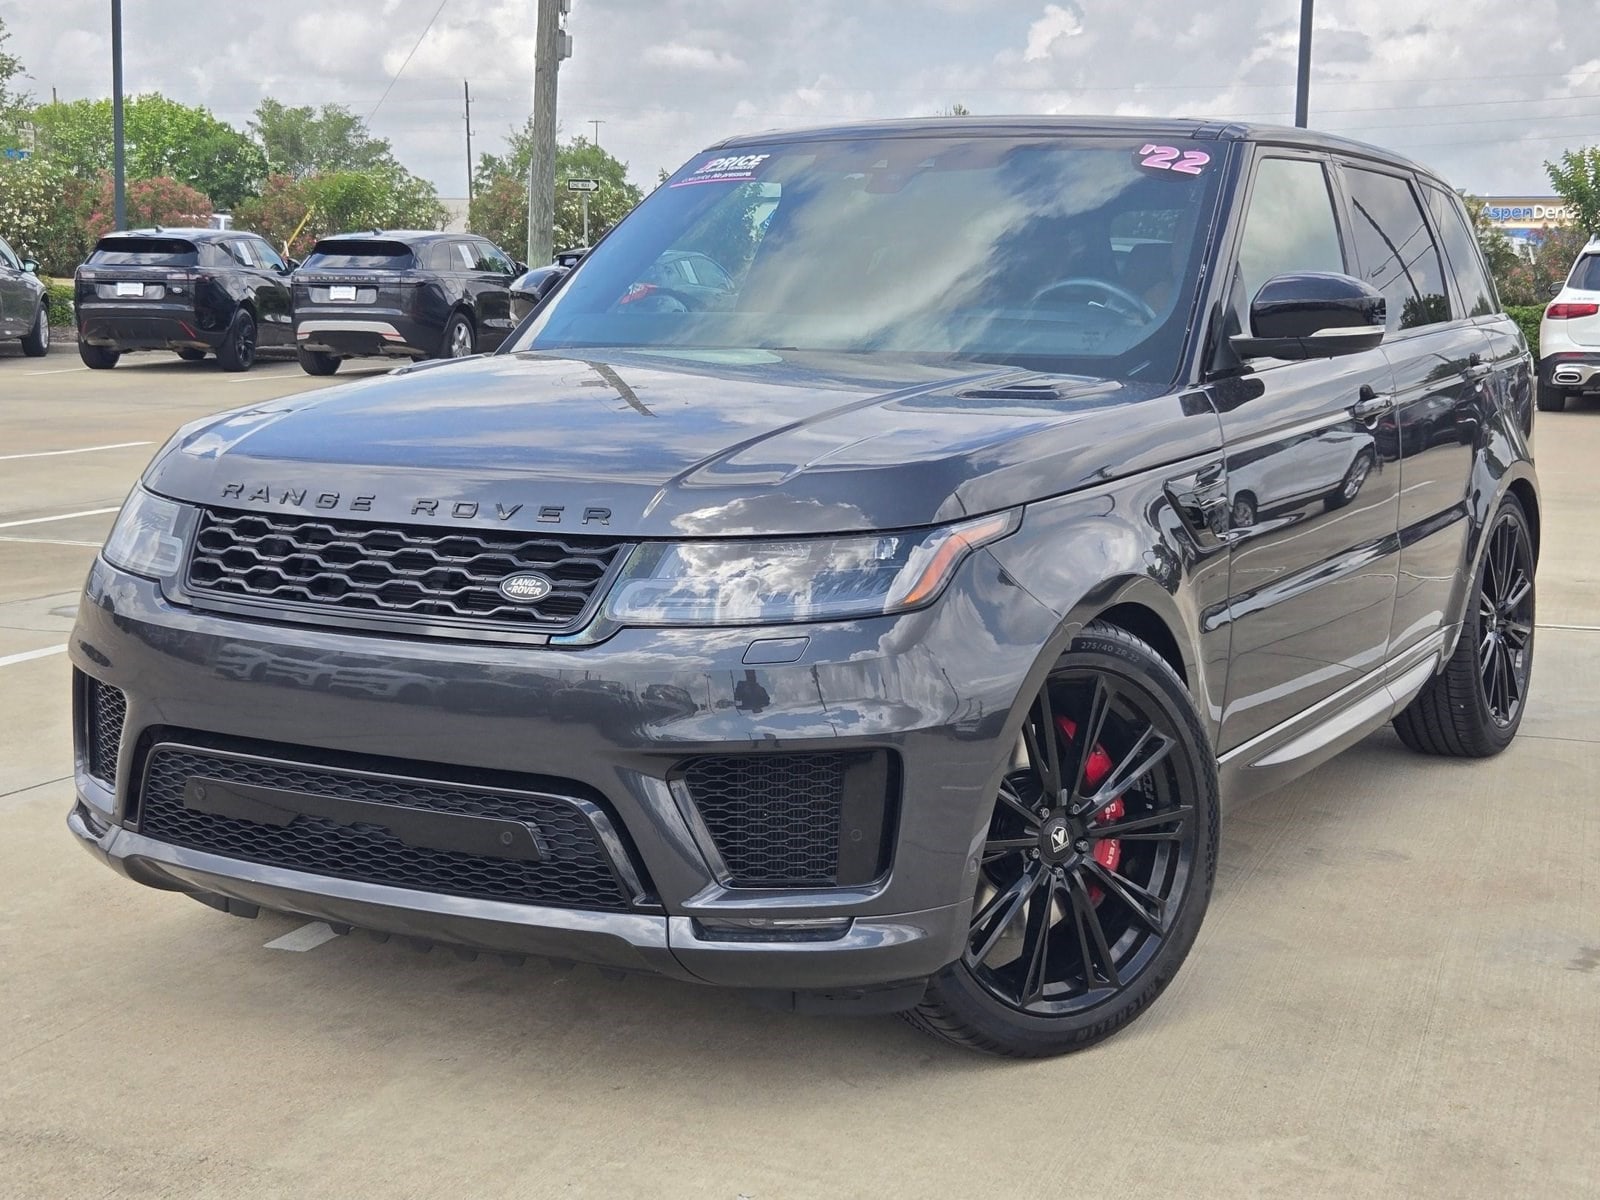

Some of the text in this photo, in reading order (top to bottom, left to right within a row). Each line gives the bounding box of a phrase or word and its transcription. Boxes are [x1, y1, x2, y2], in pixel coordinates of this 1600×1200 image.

[1139, 144, 1210, 175] '22
[1482, 203, 1582, 222] AspenDen
[221, 483, 613, 526] RANGE ROVER
[510, 578, 537, 587] LAND
[510, 585, 542, 596] ROVER
[1080, 641, 1114, 652] 275/40
[1115, 647, 1128, 657] ZR
[1105, 838, 1117, 865] VER
